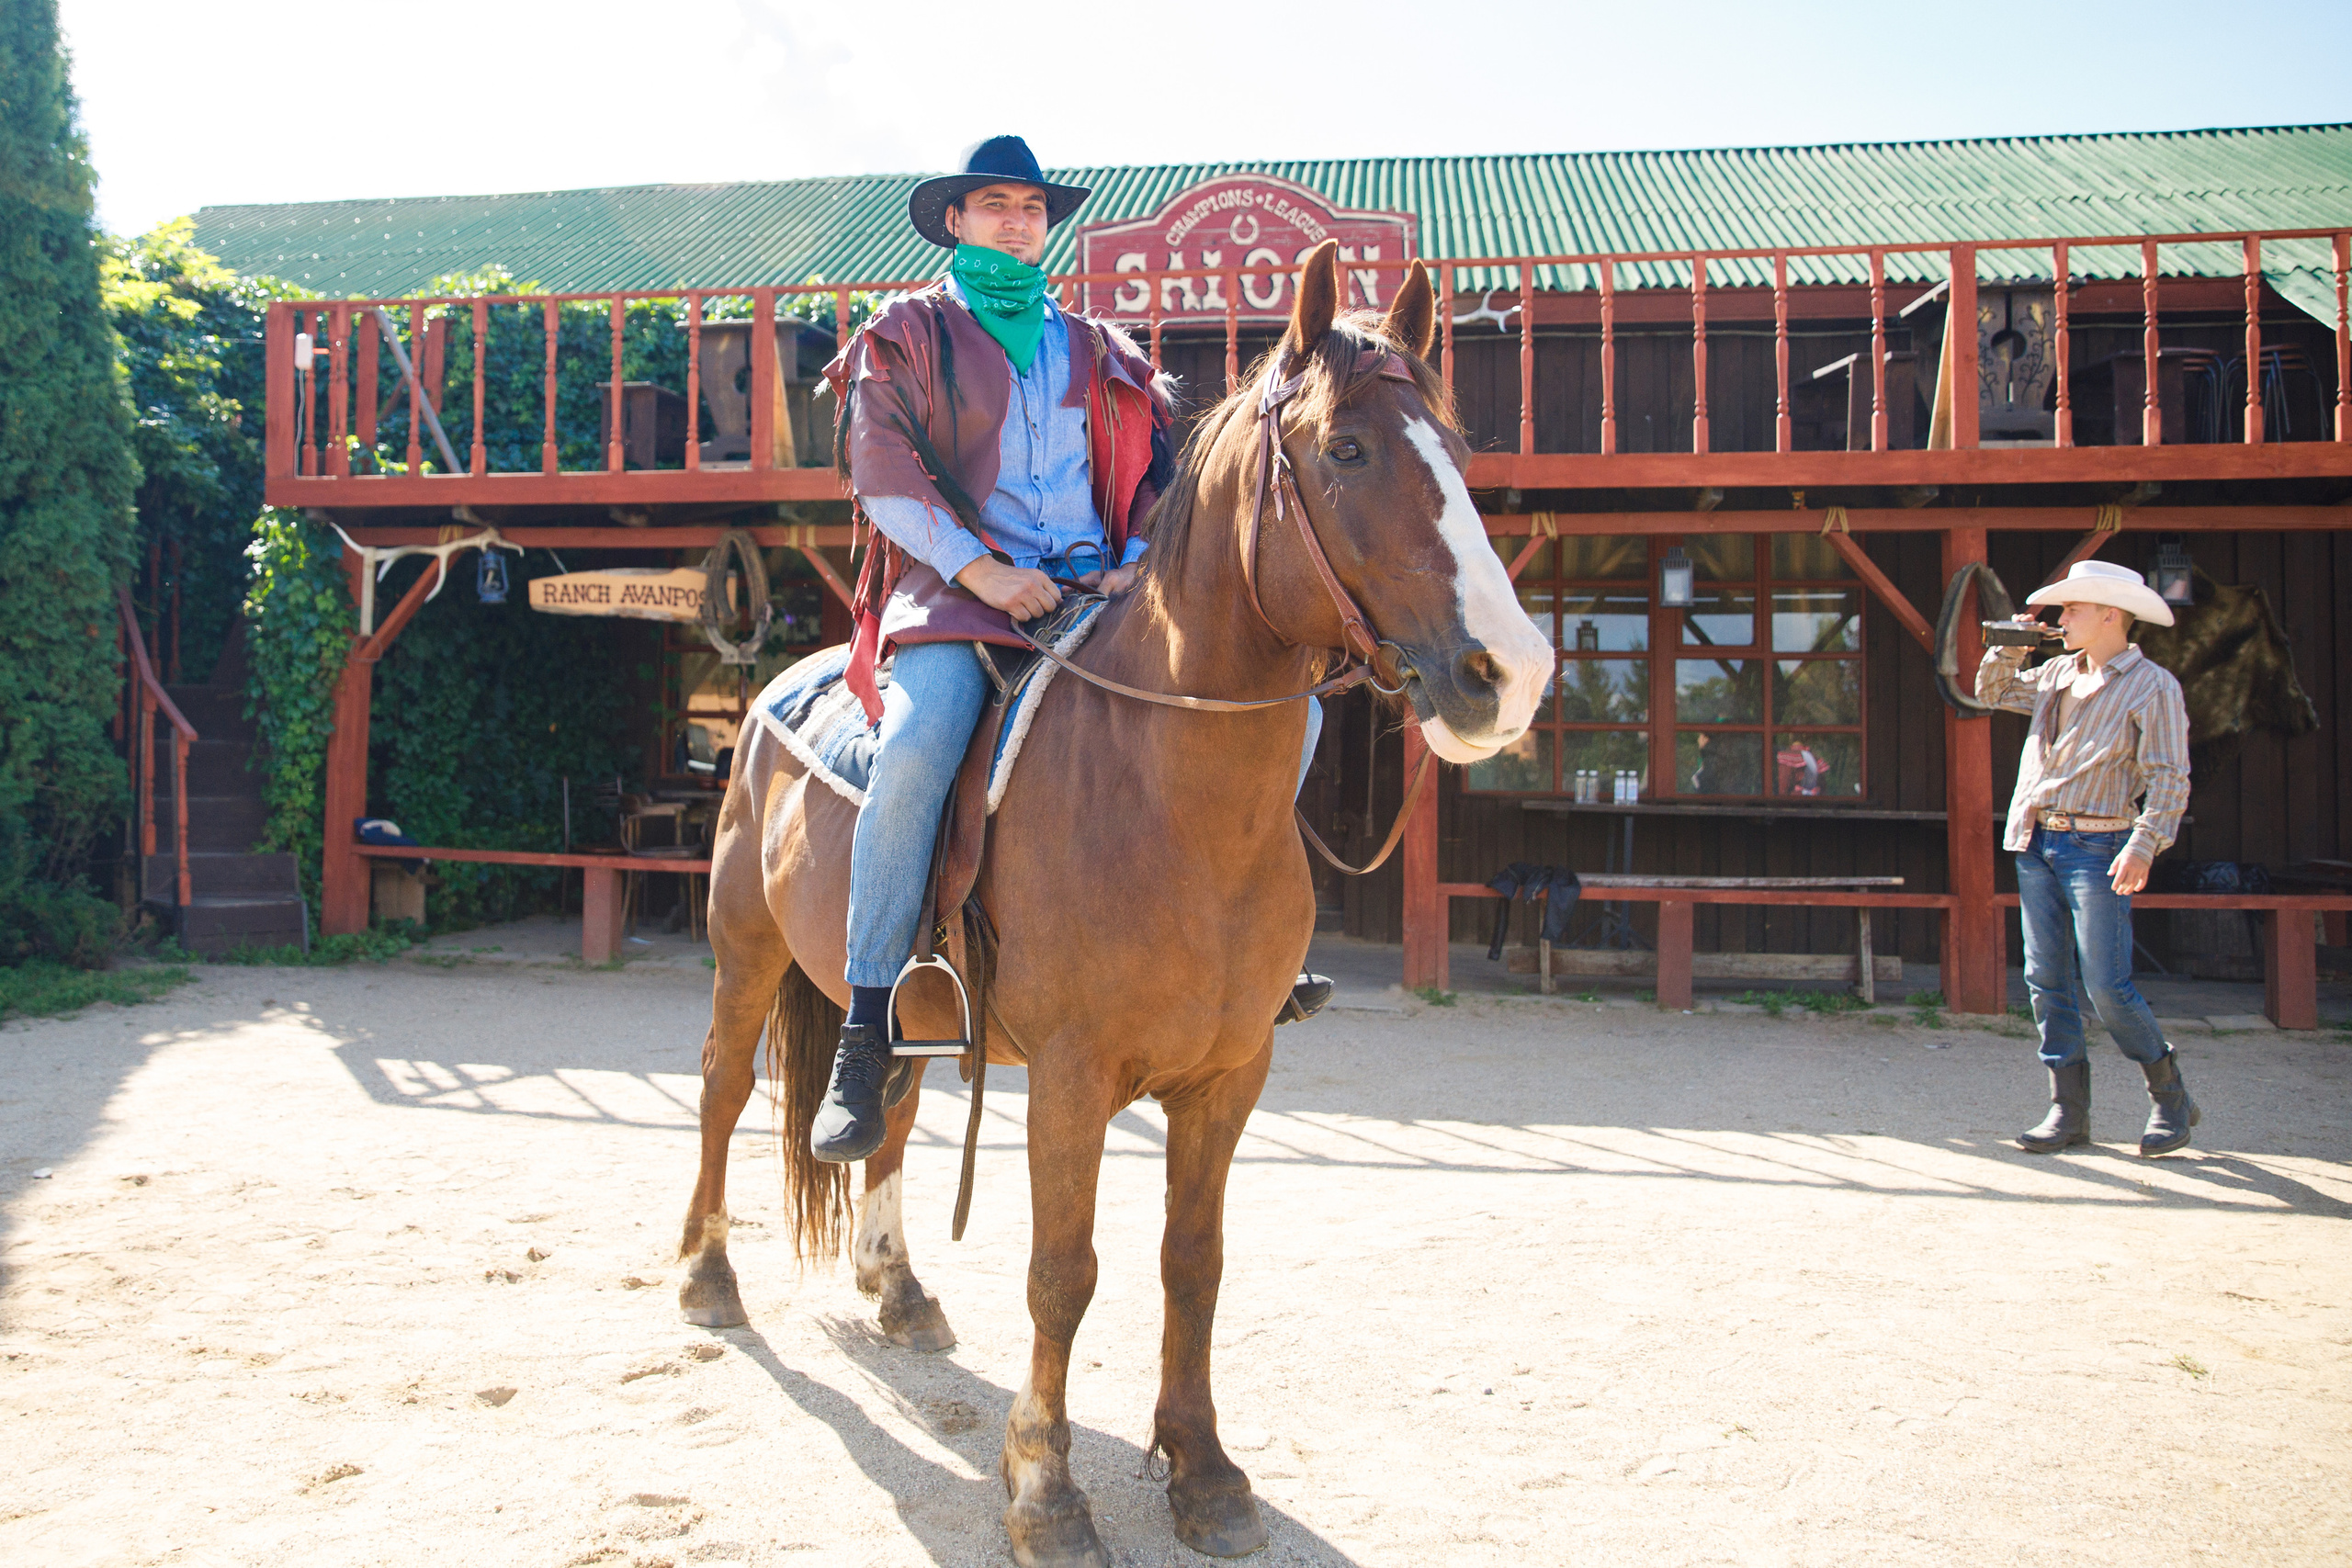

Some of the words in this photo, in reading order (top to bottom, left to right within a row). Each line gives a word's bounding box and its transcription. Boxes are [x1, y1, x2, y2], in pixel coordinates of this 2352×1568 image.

[1165, 187, 1255, 247] CHAMPIONS
[1262, 191, 1329, 244] LEAGUE
[1114, 248, 1381, 313] SALON
[543, 583, 610, 604] RANCH
